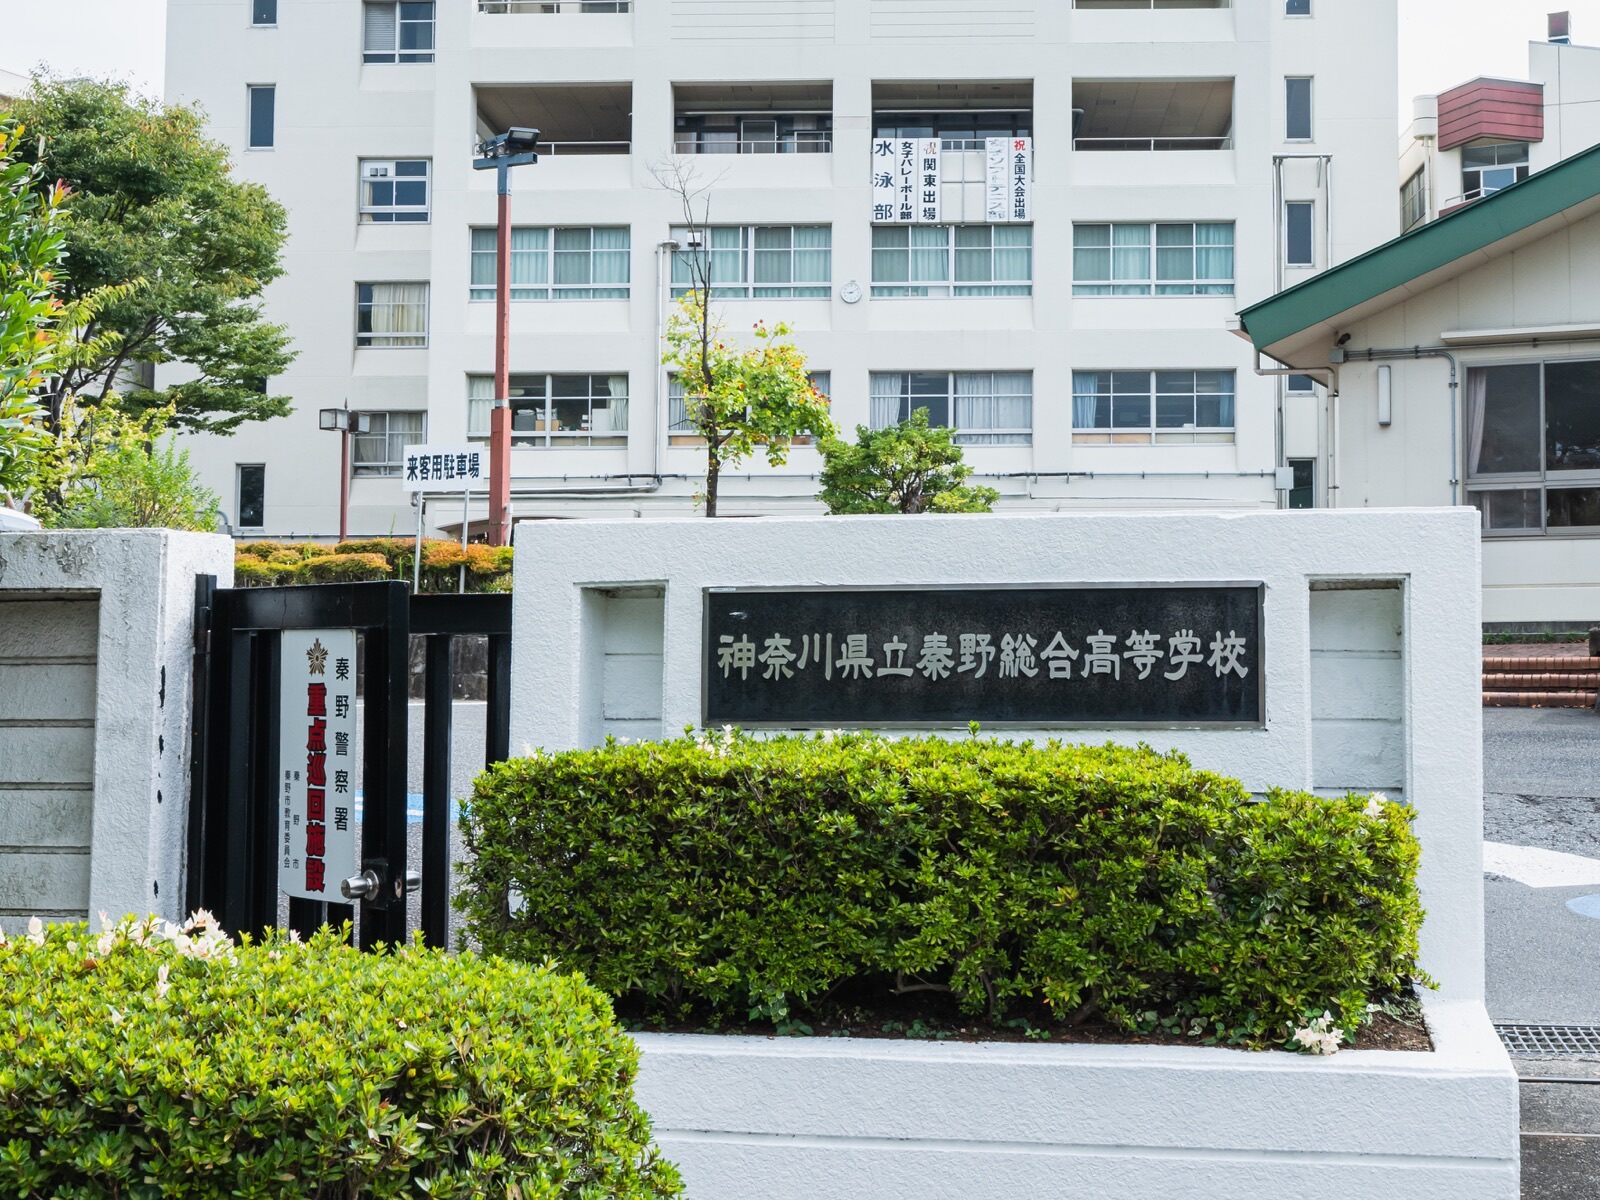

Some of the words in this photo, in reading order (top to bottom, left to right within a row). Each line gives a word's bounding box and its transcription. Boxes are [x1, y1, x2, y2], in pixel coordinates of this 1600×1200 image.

[873, 140, 895, 220] 水泳部
[900, 141, 913, 220] 女子バレーボール部
[1014, 139, 1026, 220] 祝全国大会出場
[407, 452, 480, 481] 来客用駐車場
[717, 629, 1249, 681] 神奈川県立秦野総合高等学校
[334, 657, 349, 832] 秦野警察署
[306, 682, 327, 892] 重点巡回施設
